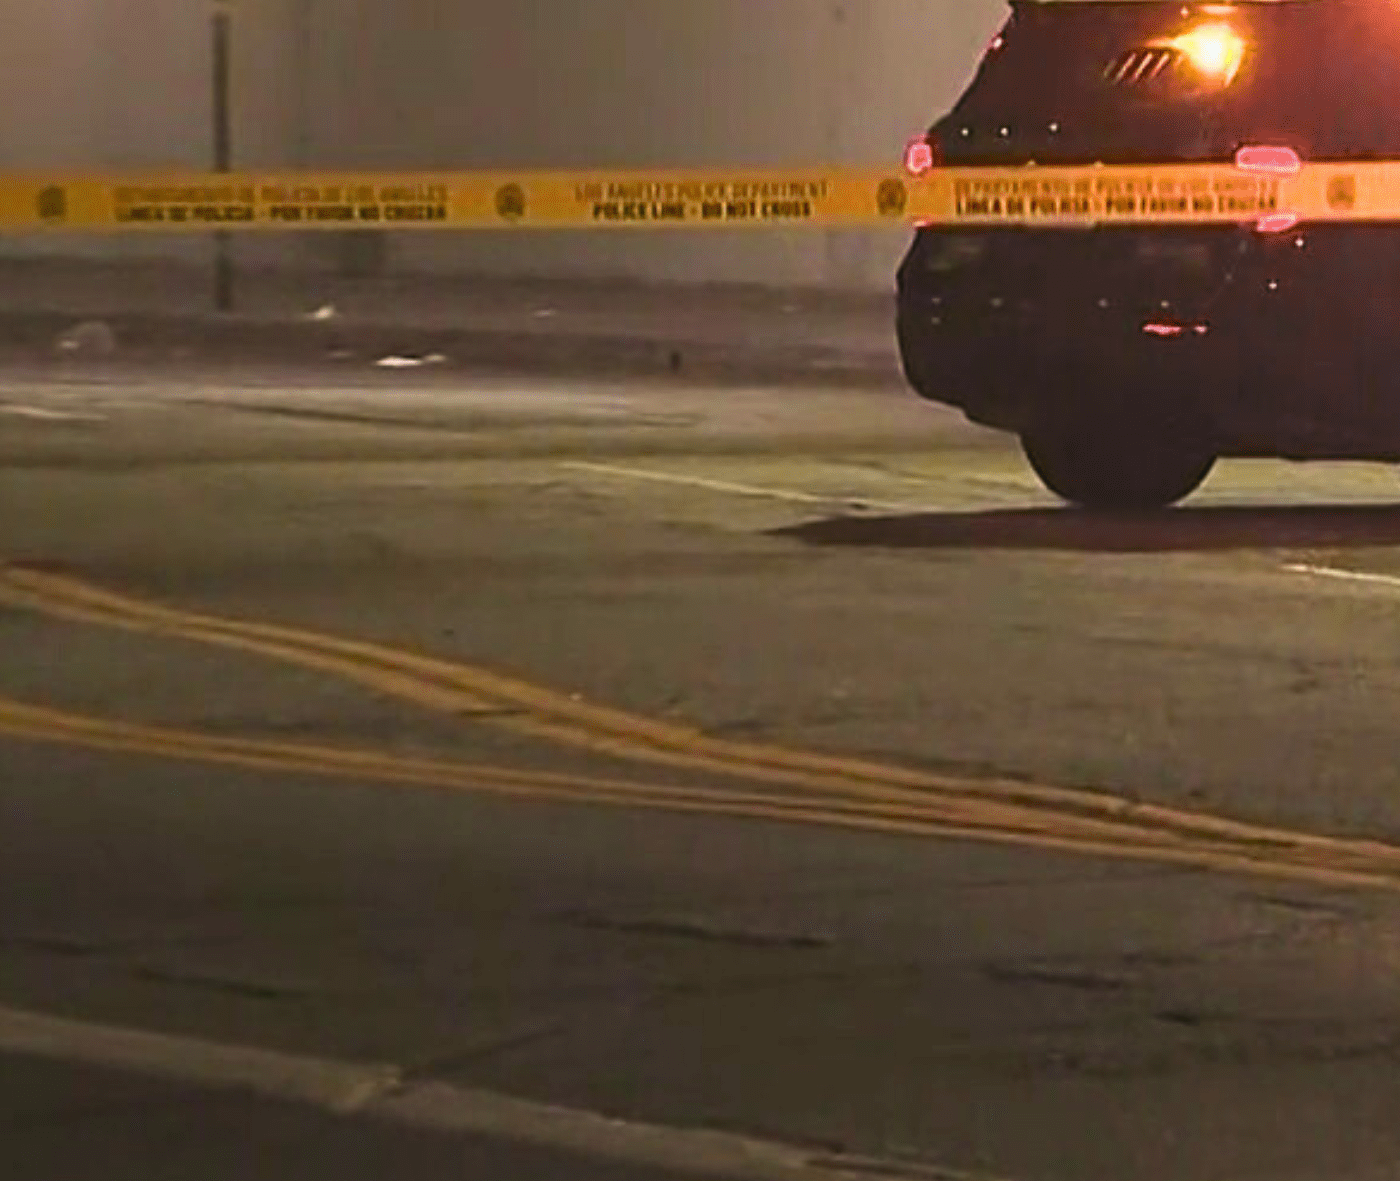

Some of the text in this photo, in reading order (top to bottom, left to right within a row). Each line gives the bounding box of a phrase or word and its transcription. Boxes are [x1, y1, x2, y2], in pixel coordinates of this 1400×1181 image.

[593, 203, 646, 218] POLICE
[651, 203, 684, 218] LINE
[727, 203, 755, 218] NOT
[762, 203, 810, 218] CROSS
